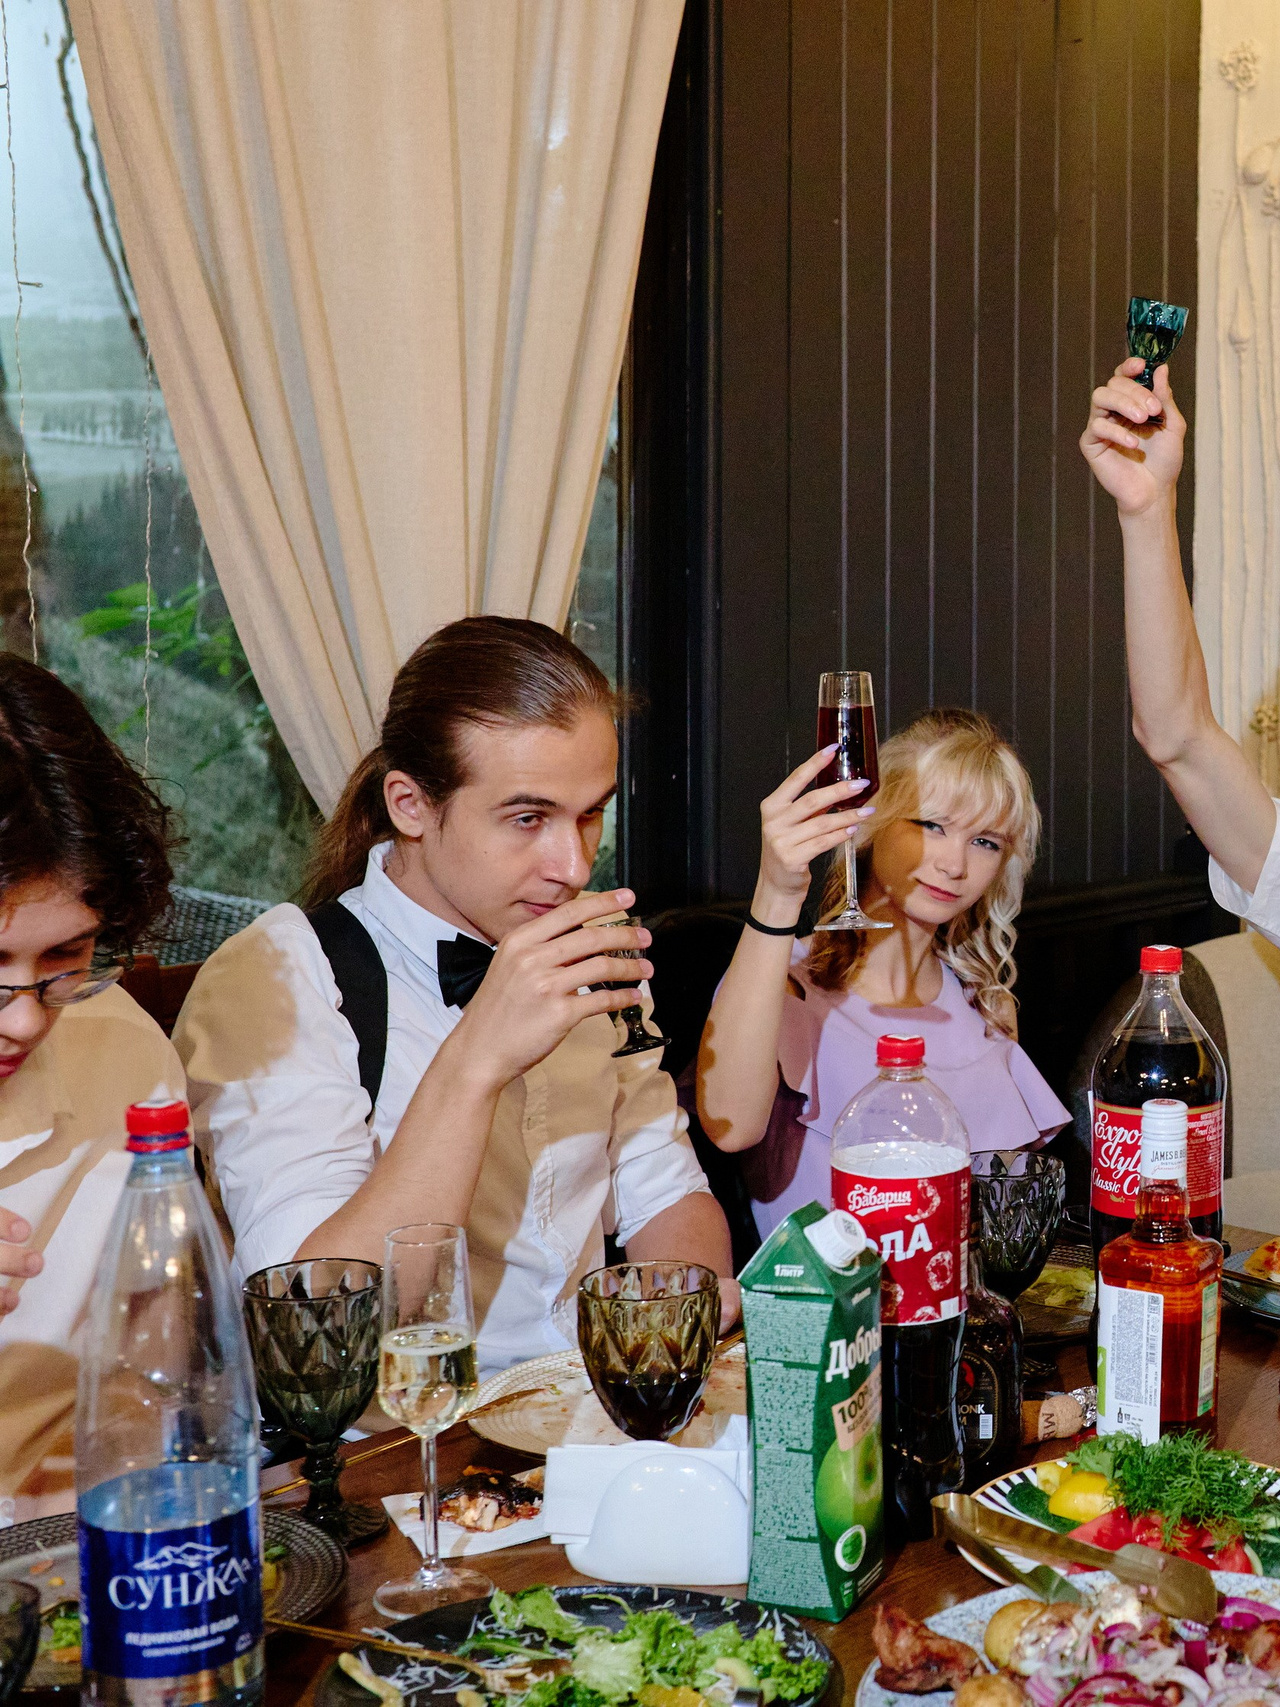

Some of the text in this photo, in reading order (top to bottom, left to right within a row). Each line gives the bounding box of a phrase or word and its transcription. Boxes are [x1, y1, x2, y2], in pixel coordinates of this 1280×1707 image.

[1151, 1150, 1174, 1162] JAMES
[1092, 1168, 1121, 1193] Classic
[847, 1184, 912, 1213] Бавария
[774, 1264, 781, 1277] 1
[779, 1269, 804, 1278] ЛИТР
[958, 1403, 985, 1415] ONK
[108, 1556, 250, 1611] СУНЖА
